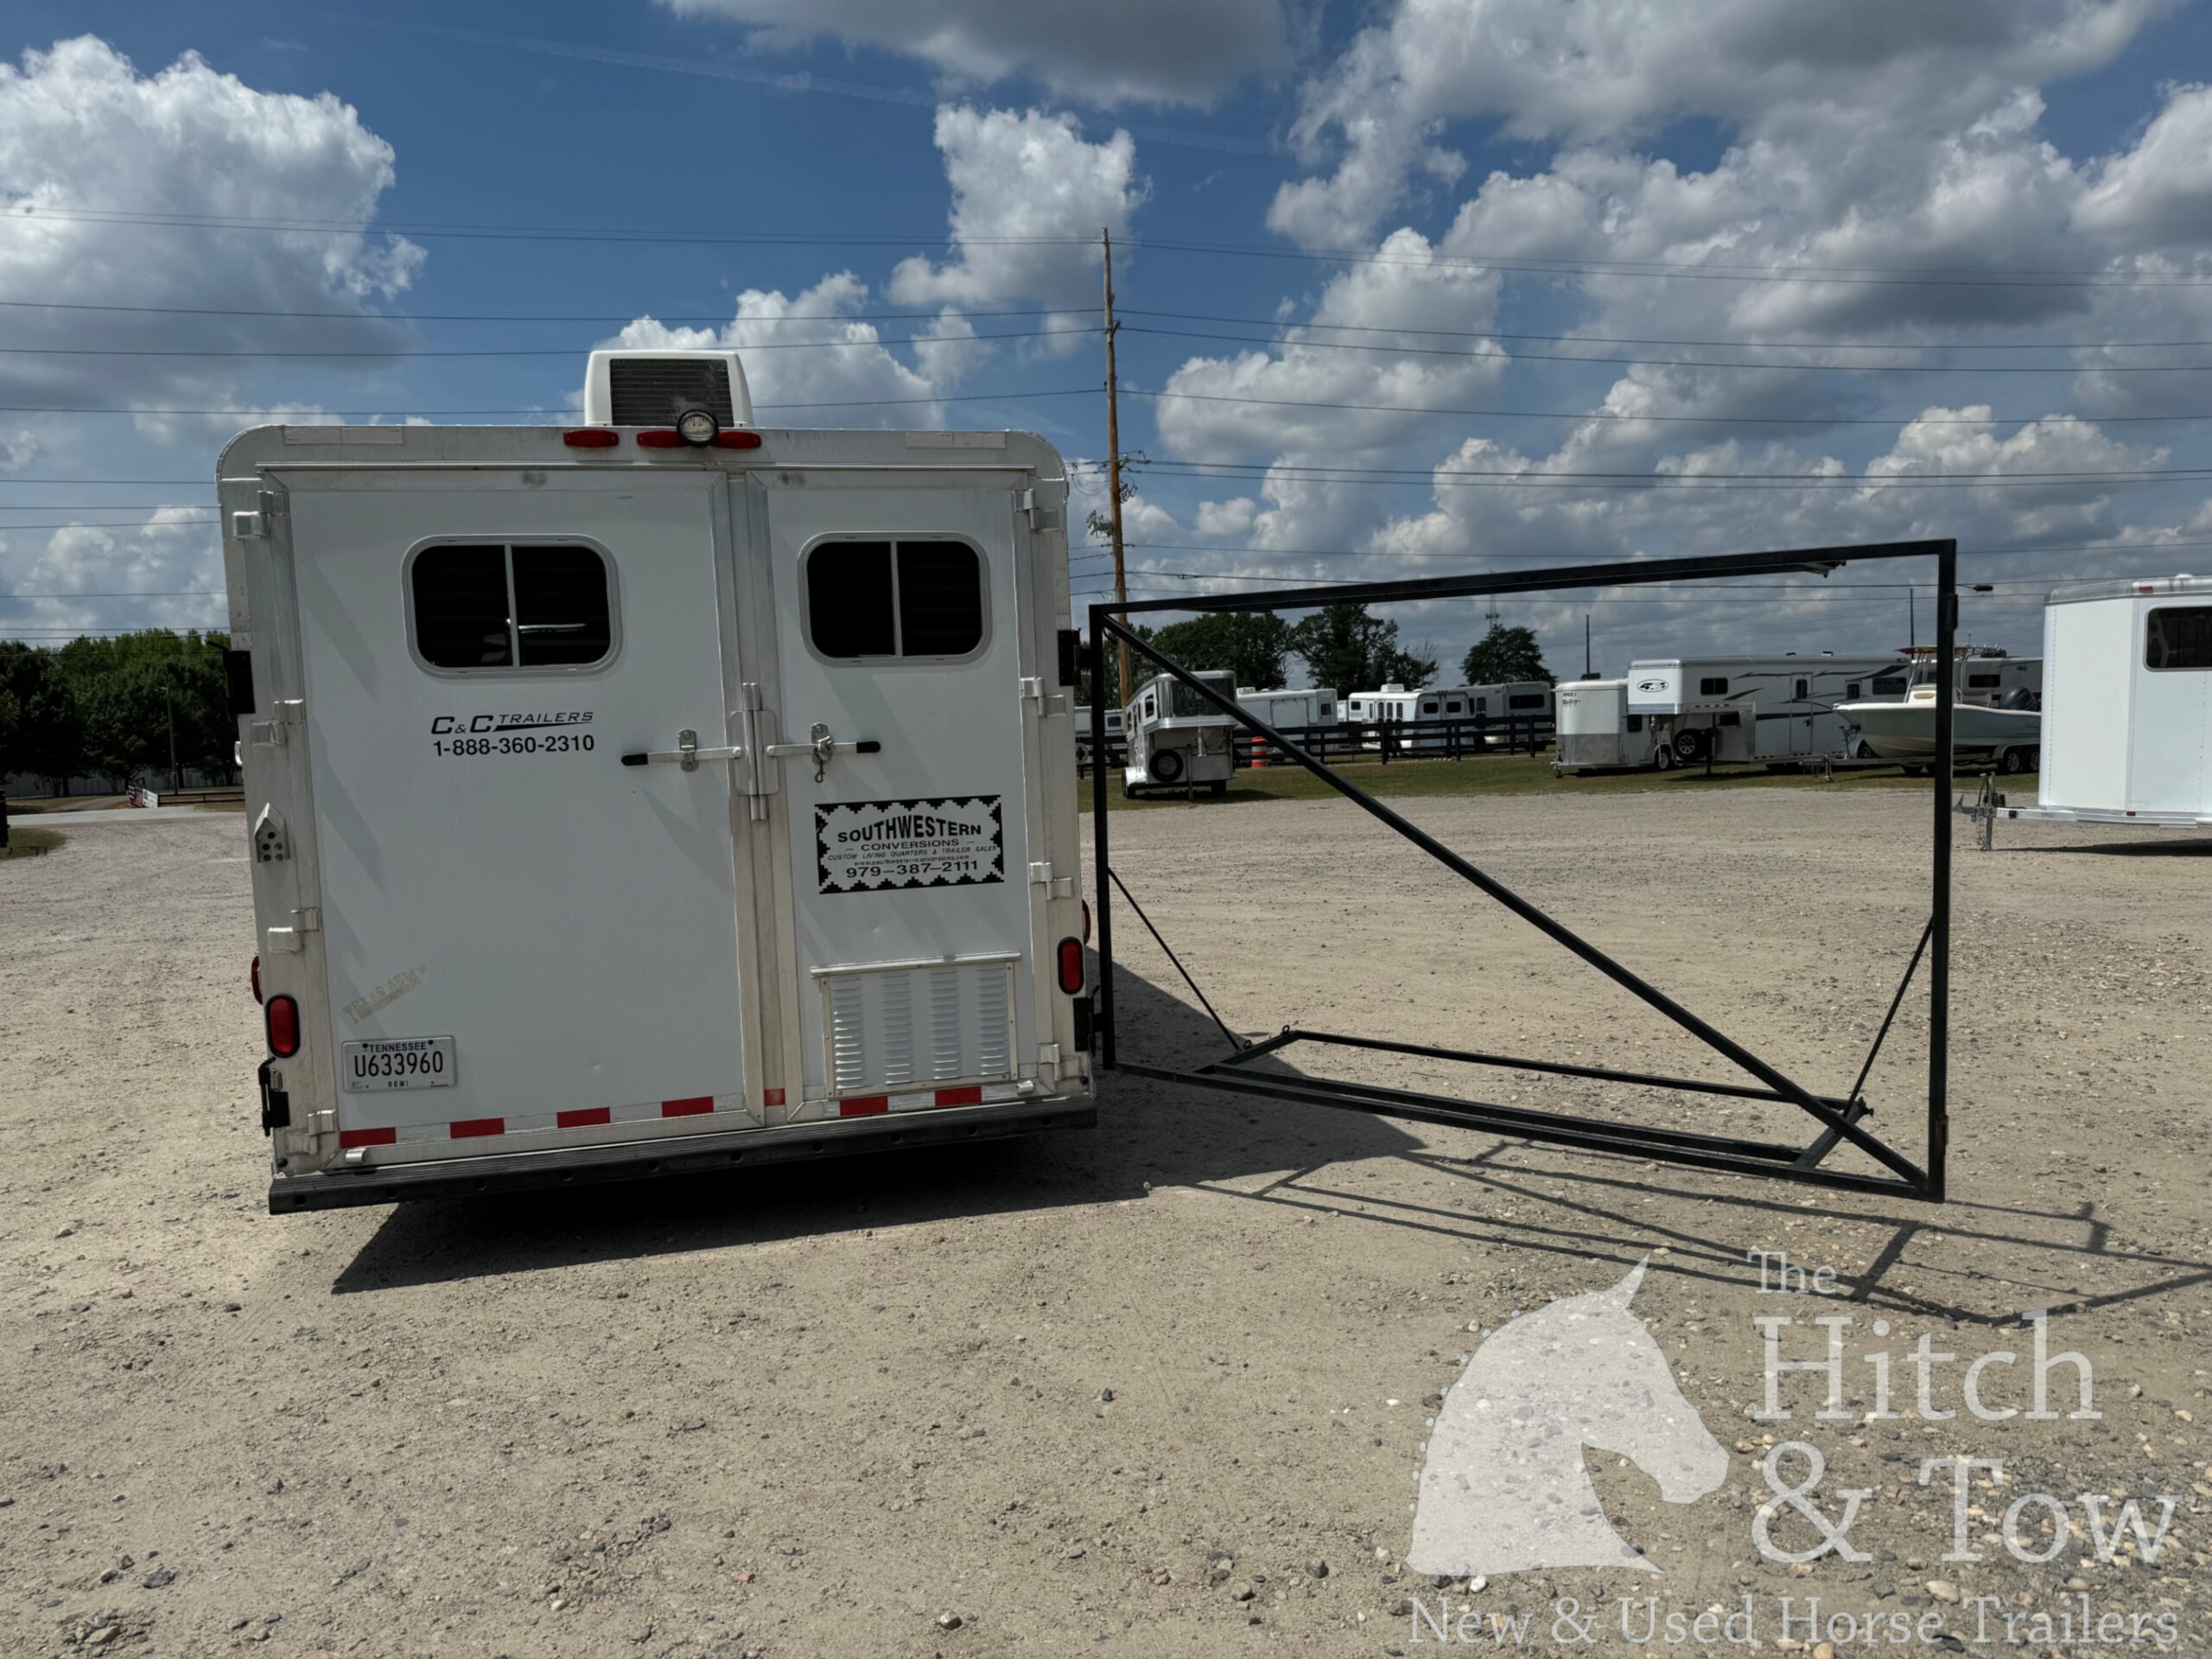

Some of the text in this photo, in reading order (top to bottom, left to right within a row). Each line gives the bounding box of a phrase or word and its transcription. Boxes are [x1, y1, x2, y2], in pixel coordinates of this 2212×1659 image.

[431, 712, 594, 734] C&C TRAILERS
[433, 734, 594, 756] 1-888-360-2310
[837, 815, 982, 842] SOUTHWESTERN
[861, 839, 960, 852] CONVERSIONS
[890, 849, 928, 857] QUARTERS
[846, 861, 977, 878] 979-387-2111
[370, 1041, 427, 1053] TENNESSEE
[354, 1051, 443, 1077] U633960
